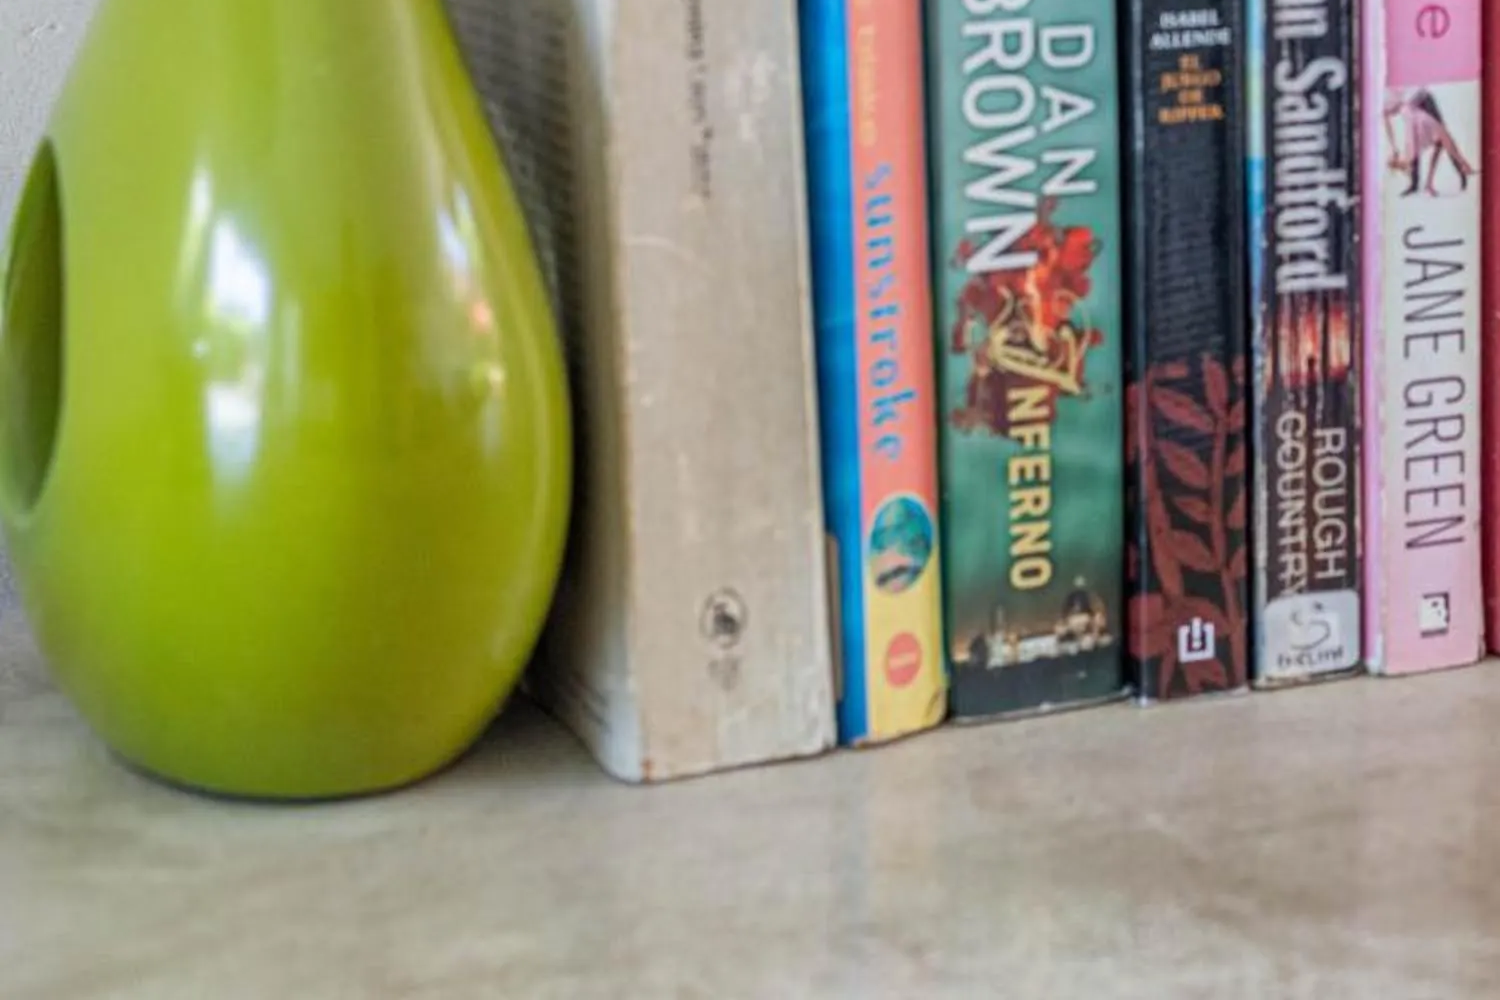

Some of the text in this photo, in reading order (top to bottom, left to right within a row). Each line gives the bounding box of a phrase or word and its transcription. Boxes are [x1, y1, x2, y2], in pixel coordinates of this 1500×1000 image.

[1040, 22, 1098, 198] DAN
[1273, 55, 1351, 295] Sandford
[865, 164, 917, 461] sunstroke
[1401, 225, 1467, 550] JANE GREEN
[1312, 427, 1348, 580] ROUGH
